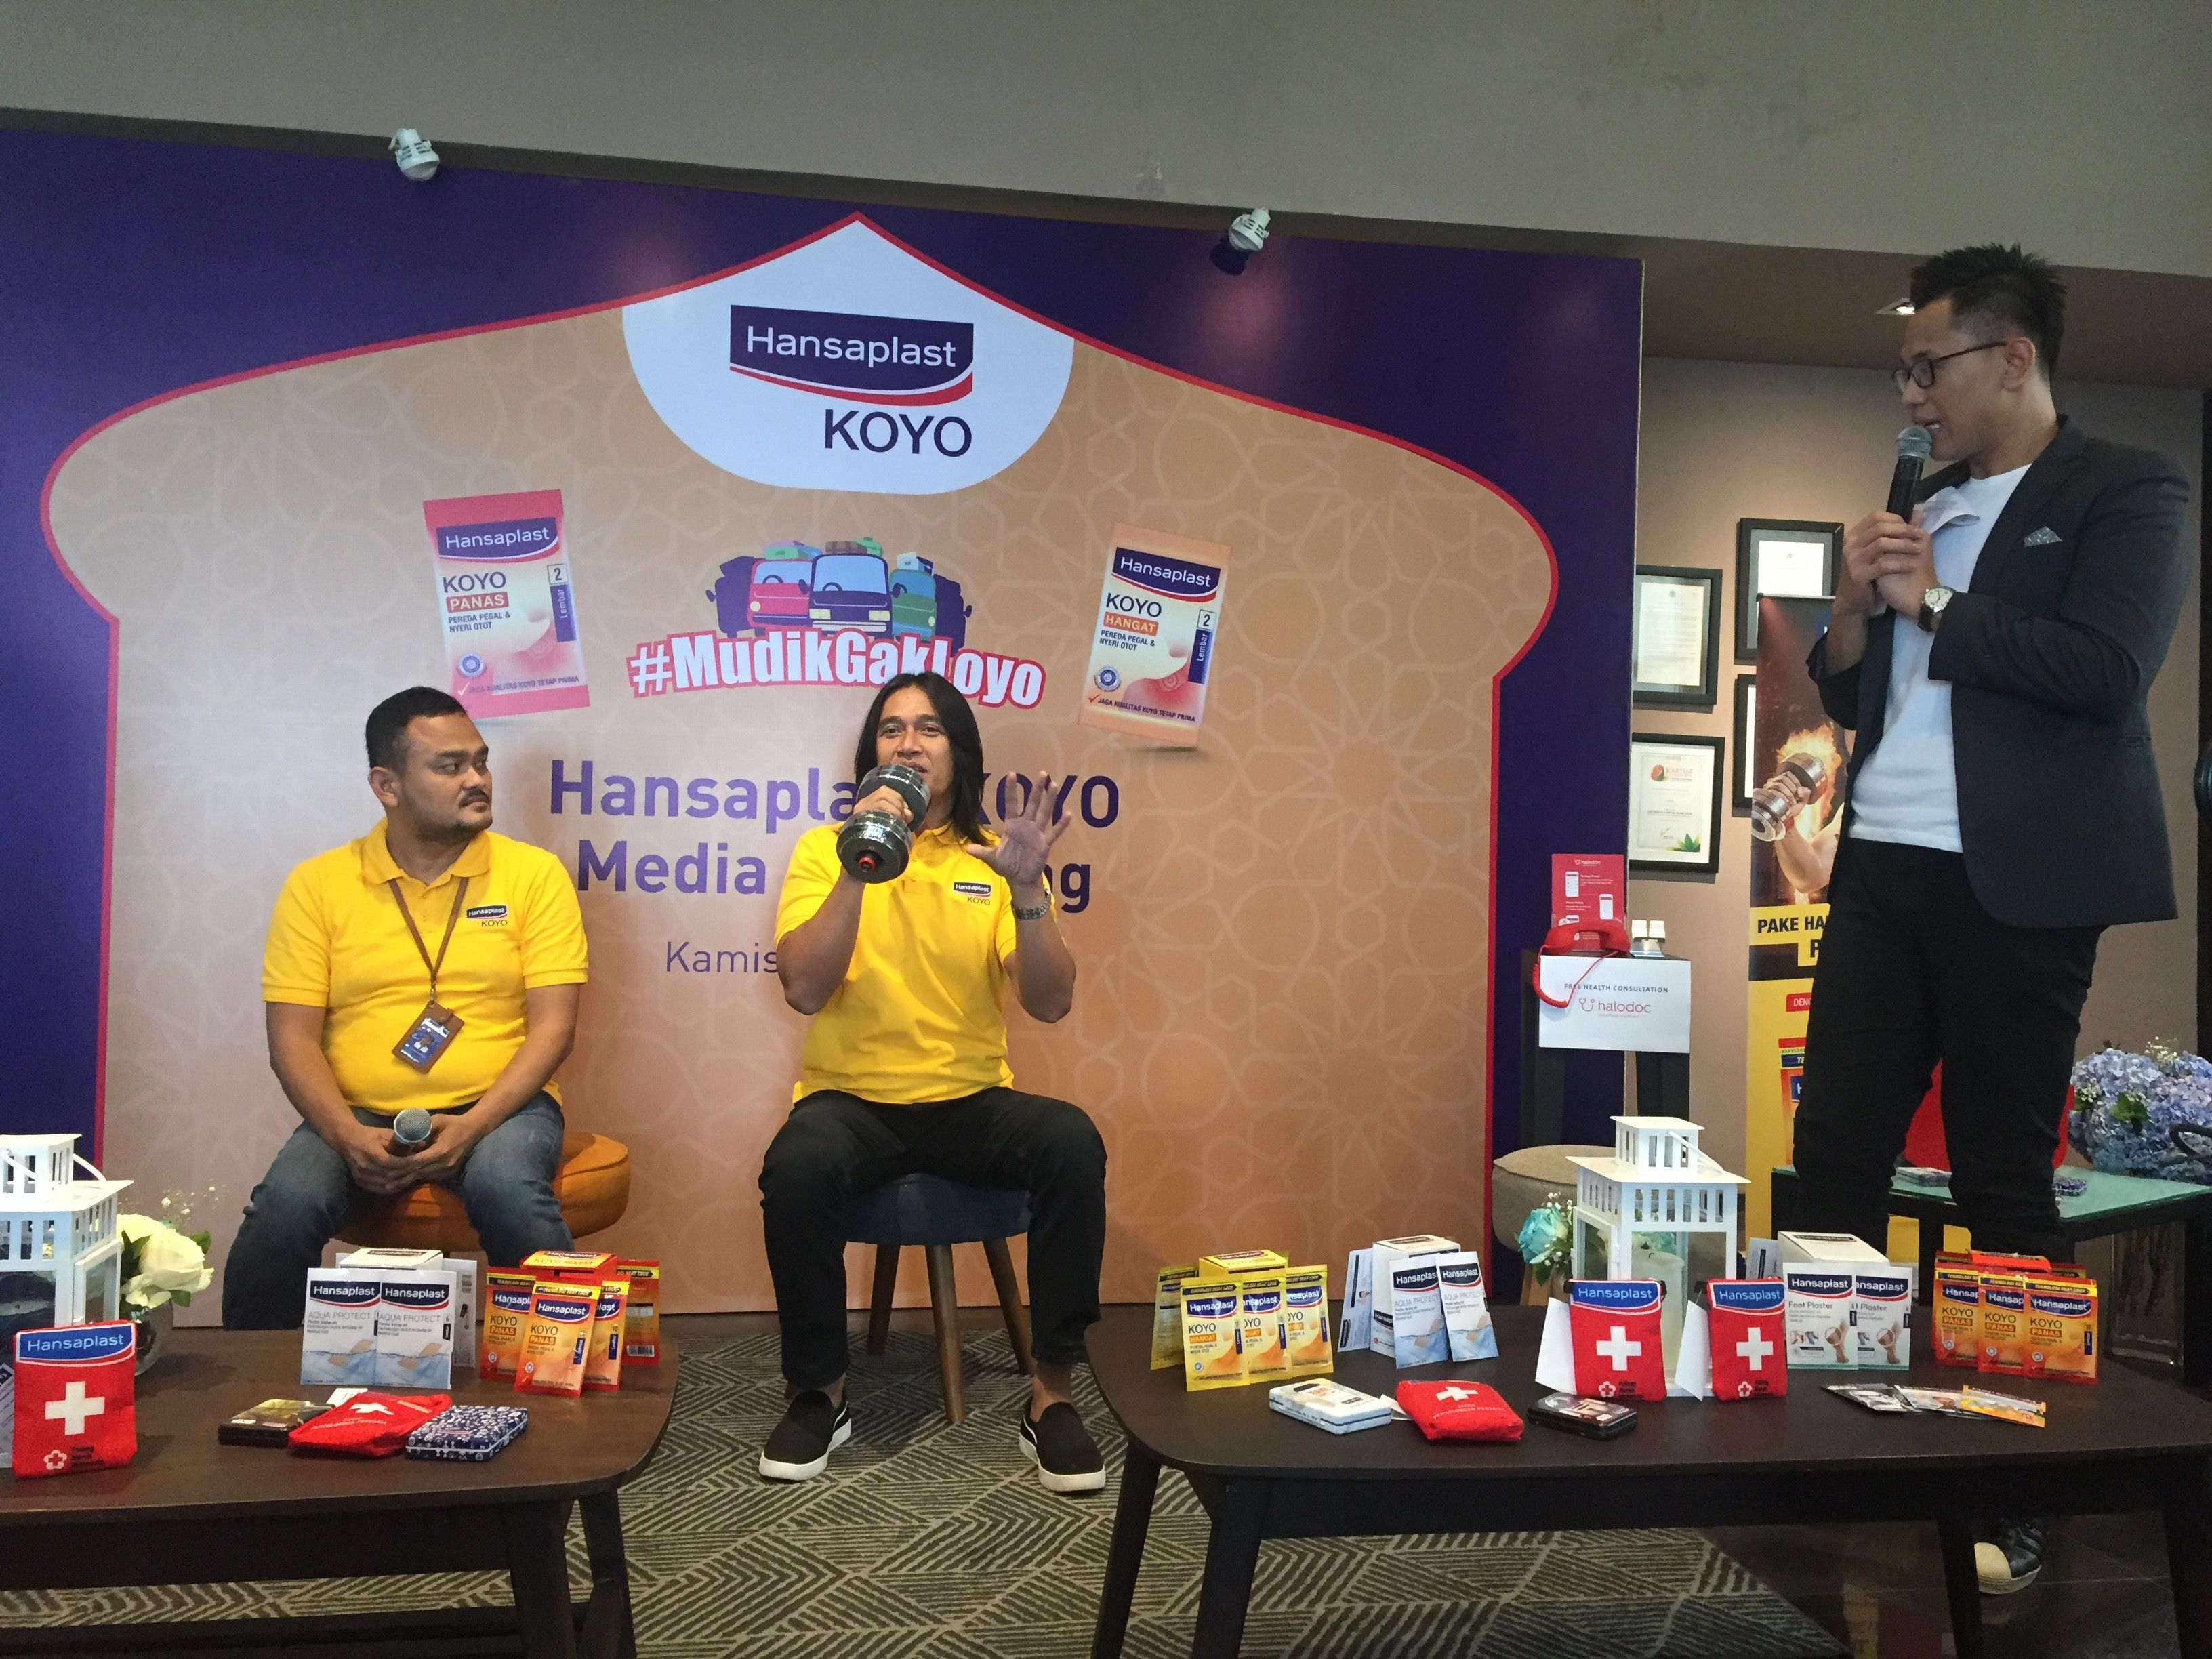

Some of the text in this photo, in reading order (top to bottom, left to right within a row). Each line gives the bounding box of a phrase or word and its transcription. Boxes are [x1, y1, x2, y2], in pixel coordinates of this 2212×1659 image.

[747, 325, 956, 367] Hansaplast
[825, 409, 972, 457] KOYO
[445, 526, 550, 550] Hansaplast
[554, 567, 562, 581] 2
[1120, 556, 1212, 588] Hansaplast
[443, 571, 506, 593] KOYO
[449, 594, 505, 610] PANAS
[557, 588, 568, 619] Lembar
[1106, 592, 1162, 617] KOYO
[448, 615, 477, 623] PEREDA
[479, 612, 503, 620] PEGAL
[1203, 613, 1211, 627] 2
[449, 622, 492, 632] NYERI OTOT
[1105, 615, 1156, 633] HANGAT
[1101, 630, 1126, 640] PEREDA
[1128, 634, 1148, 645] PEGAL
[1099, 638, 1137, 651] NYERI OTOT
[1196, 632, 1208, 662] Lembar
[1159, 710, 1176, 718] TETAP
[1176, 714, 1195, 722] PRIMA
[550, 759, 857, 835] Hansapla
[577, 839, 767, 895] Media
[956, 884, 989, 893] Hansaplast
[967, 896, 991, 905] KOYO
[468, 907, 506, 916] Hansaplast
[481, 919, 508, 927] KOYO
[1757, 917, 1799, 933] PAKE
[668, 942, 778, 973] Kamis
[1598, 1001, 1651, 1013] halodoc
[1396, 1271, 1437, 1285] Hansaplas
[1442, 1267, 1479, 1279] Hansaplast
[1792, 1278, 1849, 1291] Hansaplast
[1856, 1281, 1904, 1292] ansaplast
[314, 1285, 375, 1297] Hansaplast
[385, 1288, 445, 1299] Hansaplast
[1578, 1287, 1652, 1300] Hansaplast
[1719, 1289, 1782, 1302] Hansaplast
[1946, 1288, 1978, 1299] Hansap
[495, 1294, 531, 1305] Hansapl
[1243, 1296, 1278, 1306] ansaplast
[1394, 1299, 1412, 1308] AQUA
[1788, 1300, 1833, 1309] Foot Plaster
[1988, 1293, 2024, 1306] Hansap
[2034, 1298, 2087, 1311] Hansaplast
[537, 1303, 586, 1315] Hansaplast
[1189, 1300, 1234, 1312] Hansaplast
[1860, 1303, 1887, 1311] Plaster
[1942, 1307, 1973, 1317] KOYO
[308, 1311, 370, 1320] AQUA PROTECT
[380, 1313, 441, 1323] AQUA PROTECT
[490, 1315, 517, 1326] KOYO
[1984, 1312, 2017, 1324] KOYO
[1943, 1318, 1972, 1326] PANAS
[1986, 1324, 2014, 1332] PANAS
[2030, 1318, 2062, 1329] KOYO
[491, 1327, 514, 1336] PANAS
[531, 1324, 558, 1335] KOYO
[1189, 1323, 1216, 1334] KOYO
[2032, 1329, 2061, 1337] PANAS
[28, 1334, 124, 1352] Hansaplast
[530, 1336, 555, 1345] PANAS
